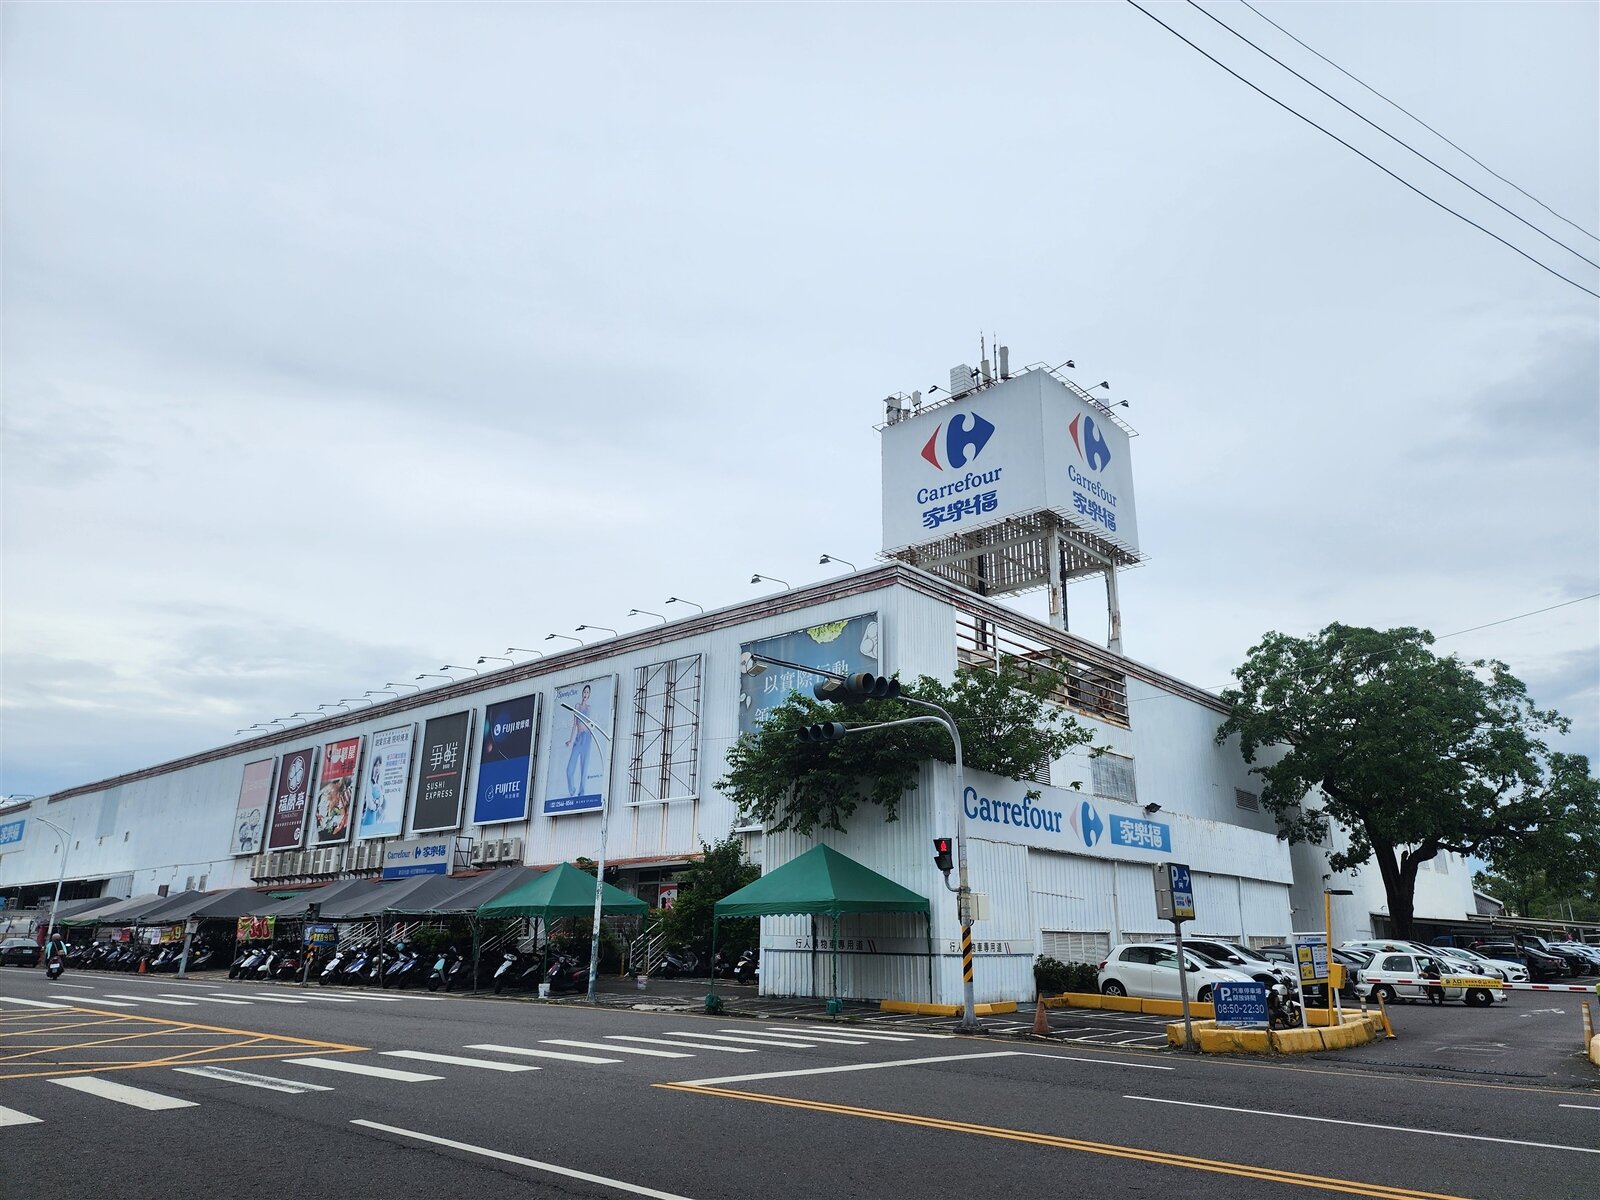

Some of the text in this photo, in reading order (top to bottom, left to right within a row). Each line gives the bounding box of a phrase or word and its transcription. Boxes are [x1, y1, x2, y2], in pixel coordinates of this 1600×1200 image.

[917, 468, 1002, 504] Carrefour
[1068, 465, 1117, 508] Carrefour
[923, 490, 999, 529] 家樂福
[1073, 490, 1117, 532] 家樂福
[502, 722, 515, 734] FUJI
[430, 741, 458, 771] 爭鮮
[425, 789, 453, 800] EXPRESS
[426, 781, 446, 791] SUSHI
[495, 780, 520, 795] FUJITEC
[963, 786, 1062, 832] Carrefour
[1119, 819, 1163, 848] 家樂福
[387, 849, 410, 859] Carrefour
[1171, 865, 1179, 888] P
[1220, 987, 1231, 1001] P
